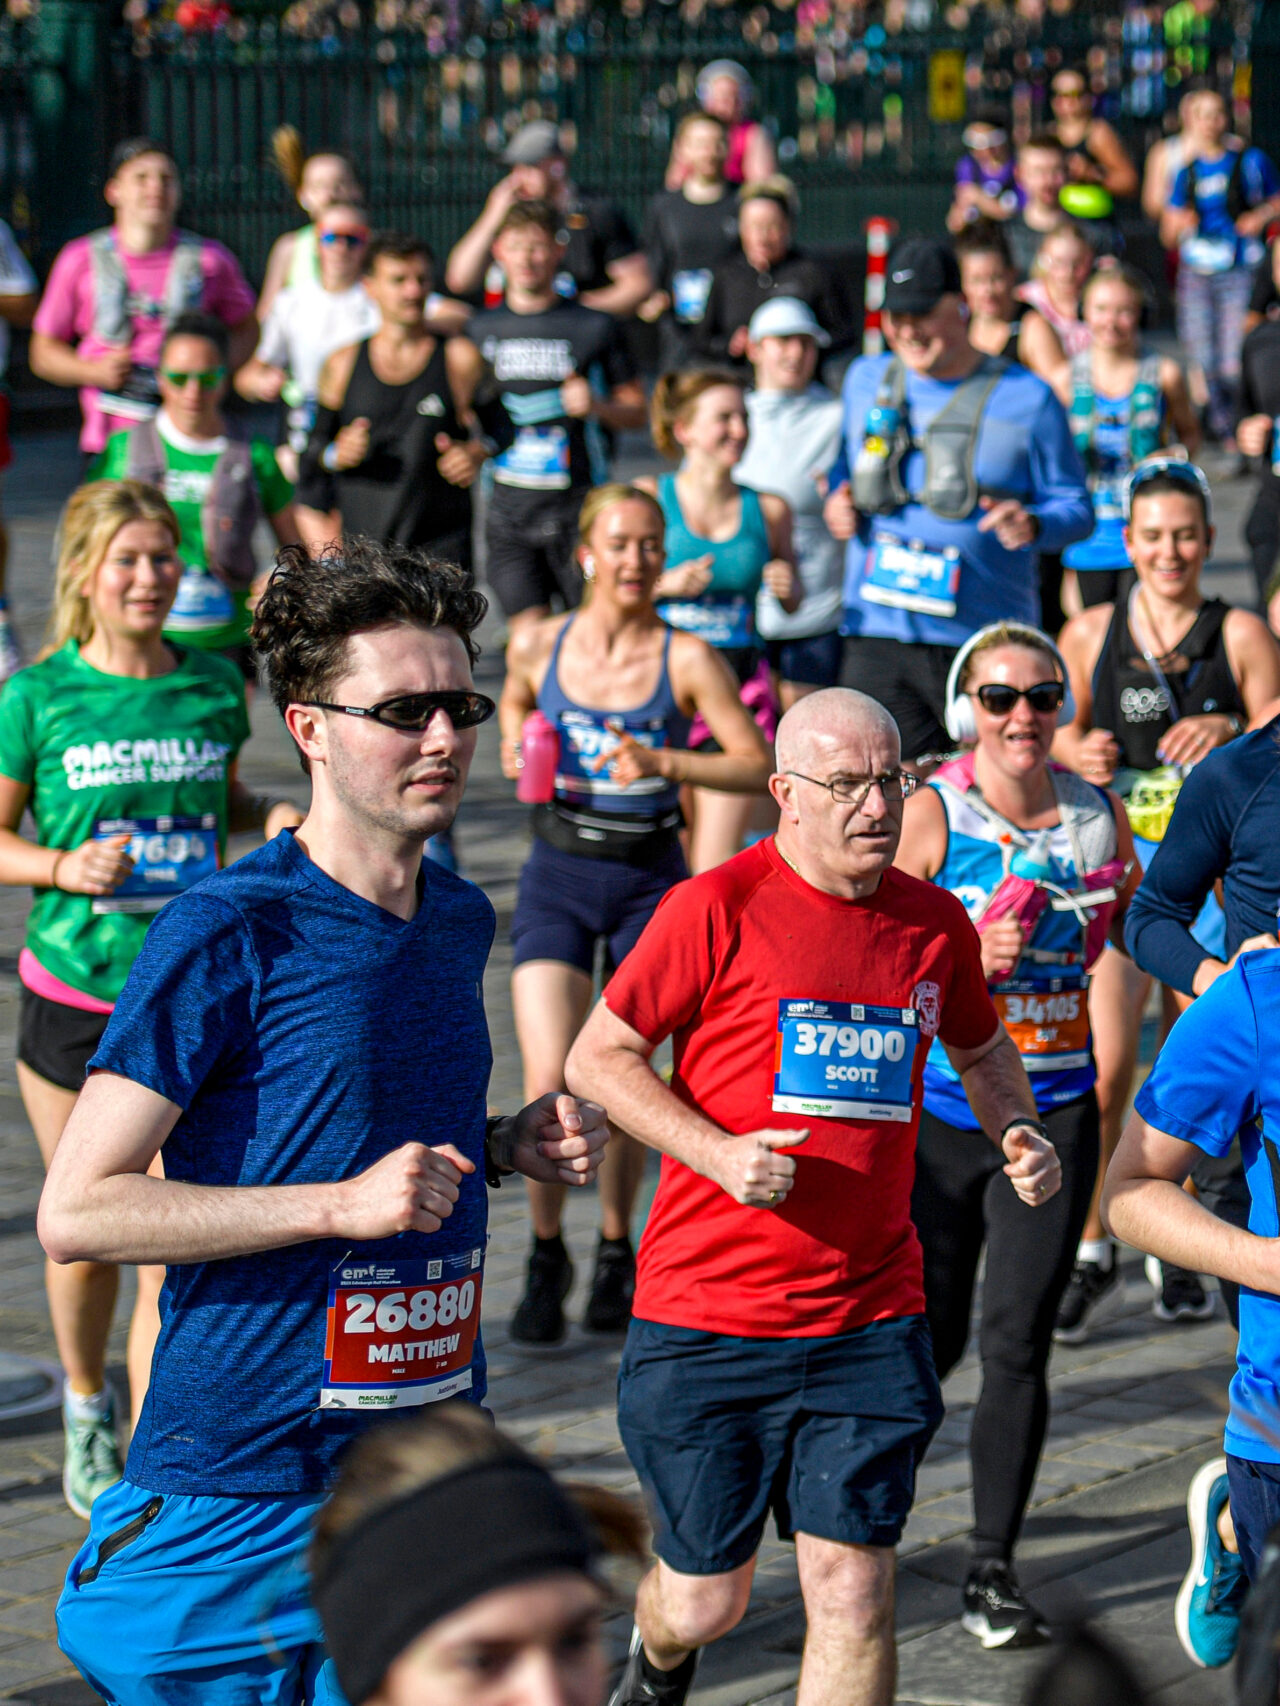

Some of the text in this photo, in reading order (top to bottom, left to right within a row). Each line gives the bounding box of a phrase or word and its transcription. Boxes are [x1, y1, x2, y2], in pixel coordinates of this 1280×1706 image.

[67, 765, 225, 790] CANCER SUPPORT
[1005, 993, 1080, 1024] 34105
[793, 1022, 906, 1062] 37900
[825, 1064, 879, 1084] SCOTT
[342, 1264, 376, 1280] emf
[344, 1280, 475, 1334] 26880
[368, 1333, 461, 1364] MATTHEW
